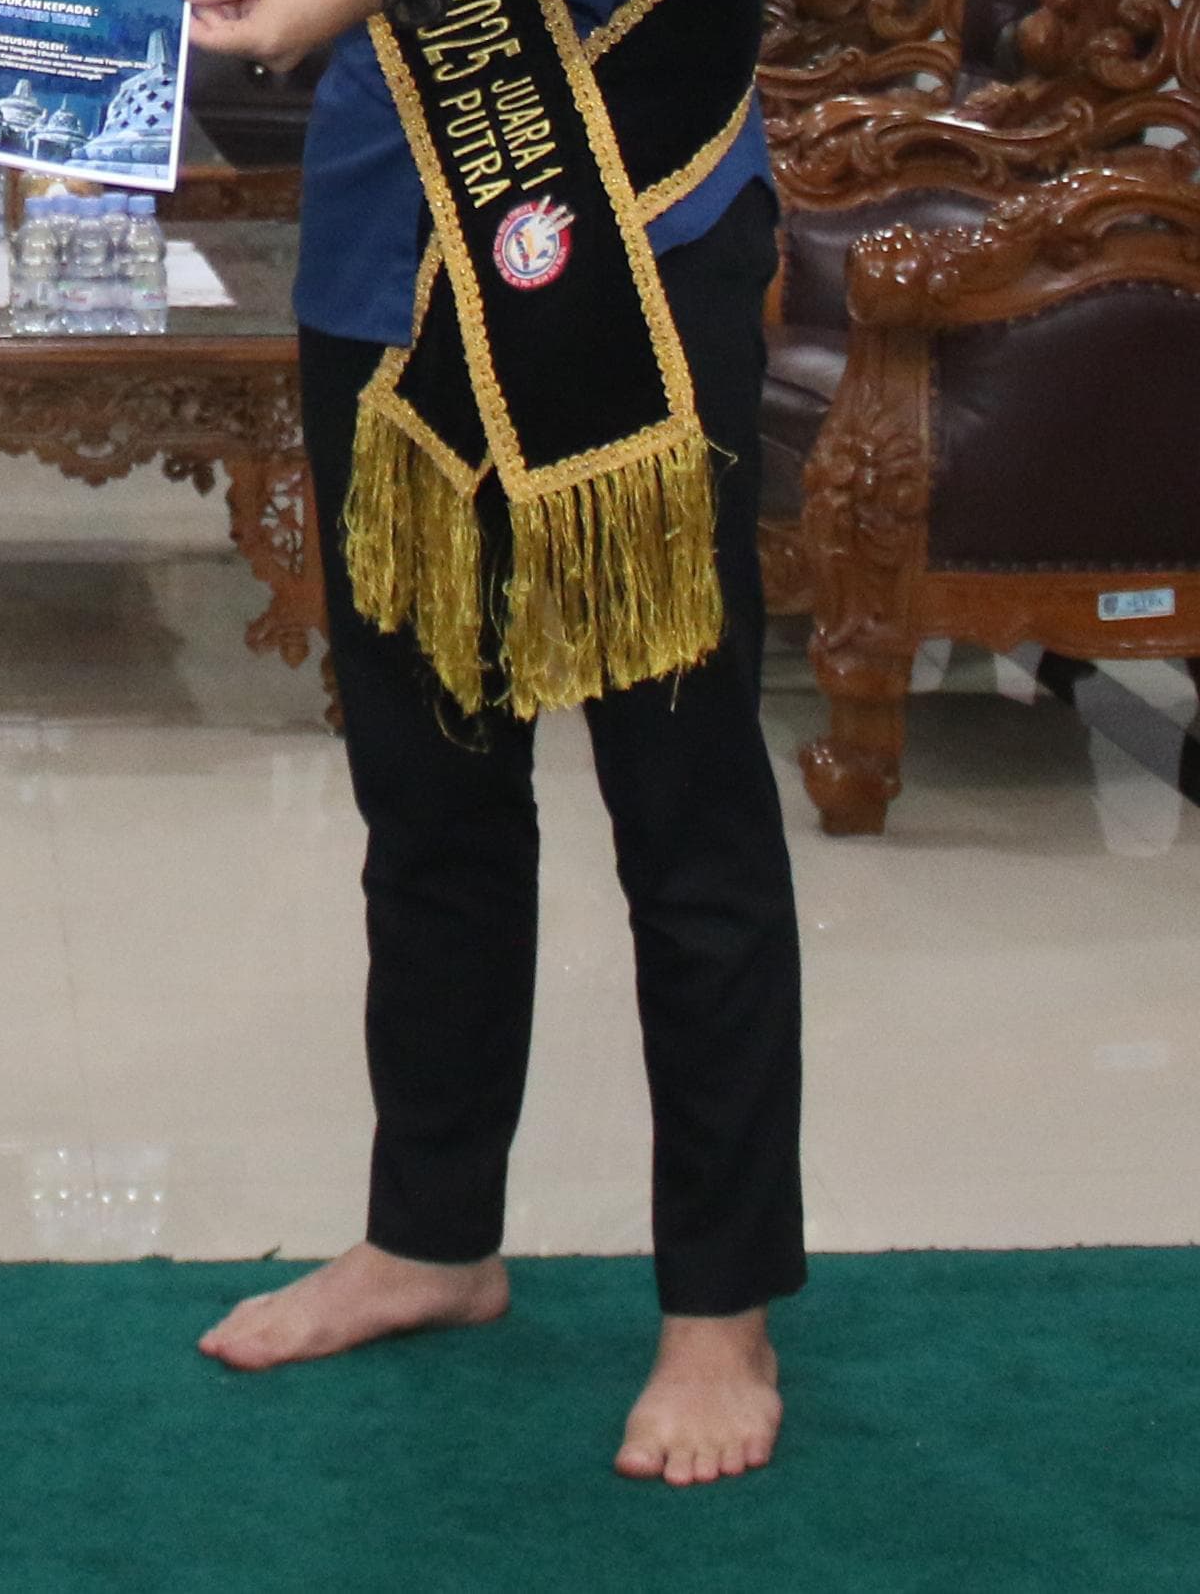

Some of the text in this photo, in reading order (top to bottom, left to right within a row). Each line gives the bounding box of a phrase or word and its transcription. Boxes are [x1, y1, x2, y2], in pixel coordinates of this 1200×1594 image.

[43, 2, 92, 16] KEPADA
[439, 87, 512, 209] PUTRA
[490, 76, 557, 170] JUARA
[521, 167, 563, 191] 1
